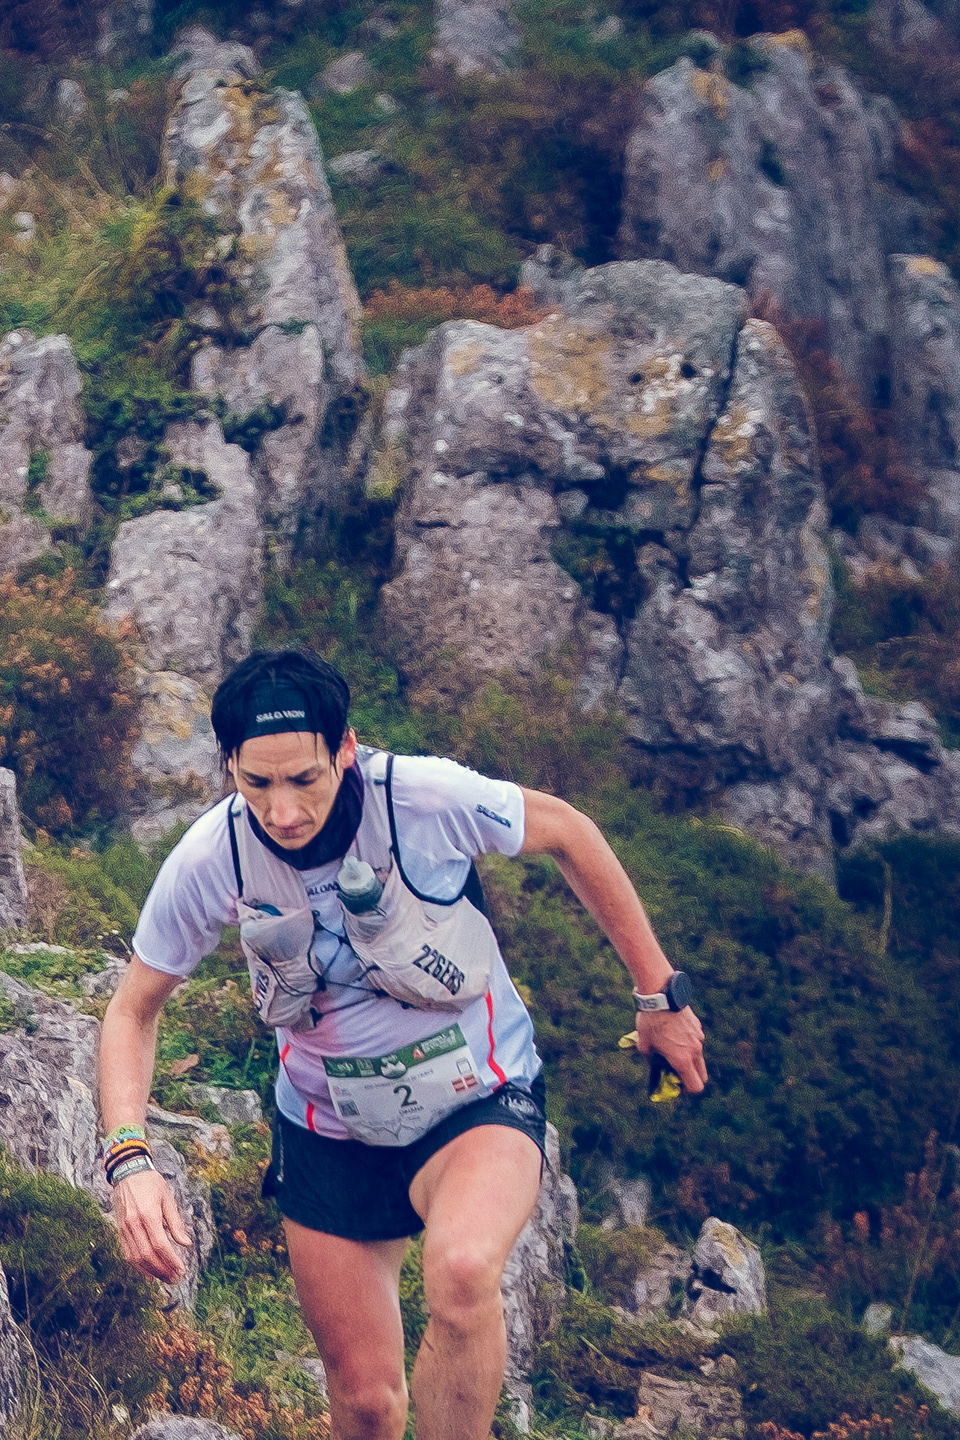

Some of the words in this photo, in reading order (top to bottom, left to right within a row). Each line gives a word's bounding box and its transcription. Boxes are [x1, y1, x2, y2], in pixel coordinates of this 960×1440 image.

[255, 709, 306, 723] SALOMON
[412, 943, 466, 996] 226ERS
[393, 1084, 419, 1107] 2
